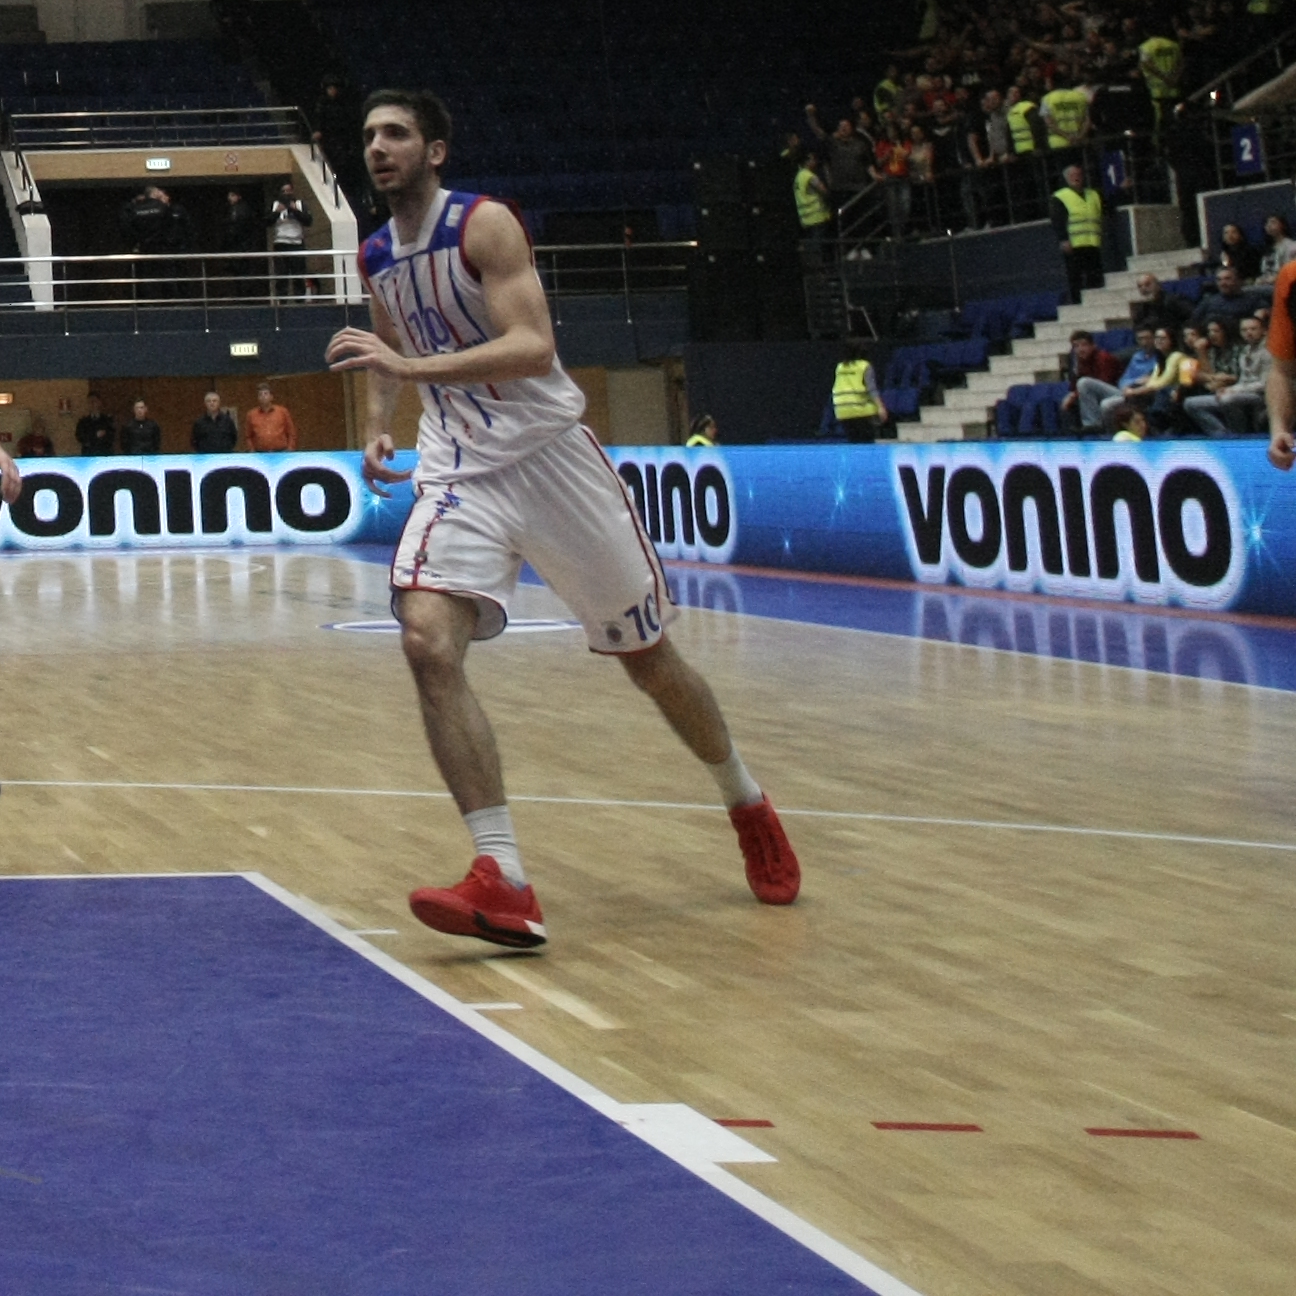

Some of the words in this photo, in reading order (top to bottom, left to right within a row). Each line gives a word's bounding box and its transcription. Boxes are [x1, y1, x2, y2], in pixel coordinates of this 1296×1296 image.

[1240, 137, 1254, 162] 2
[1108, 165, 1116, 185] 1
[408, 306, 451, 350] 10
